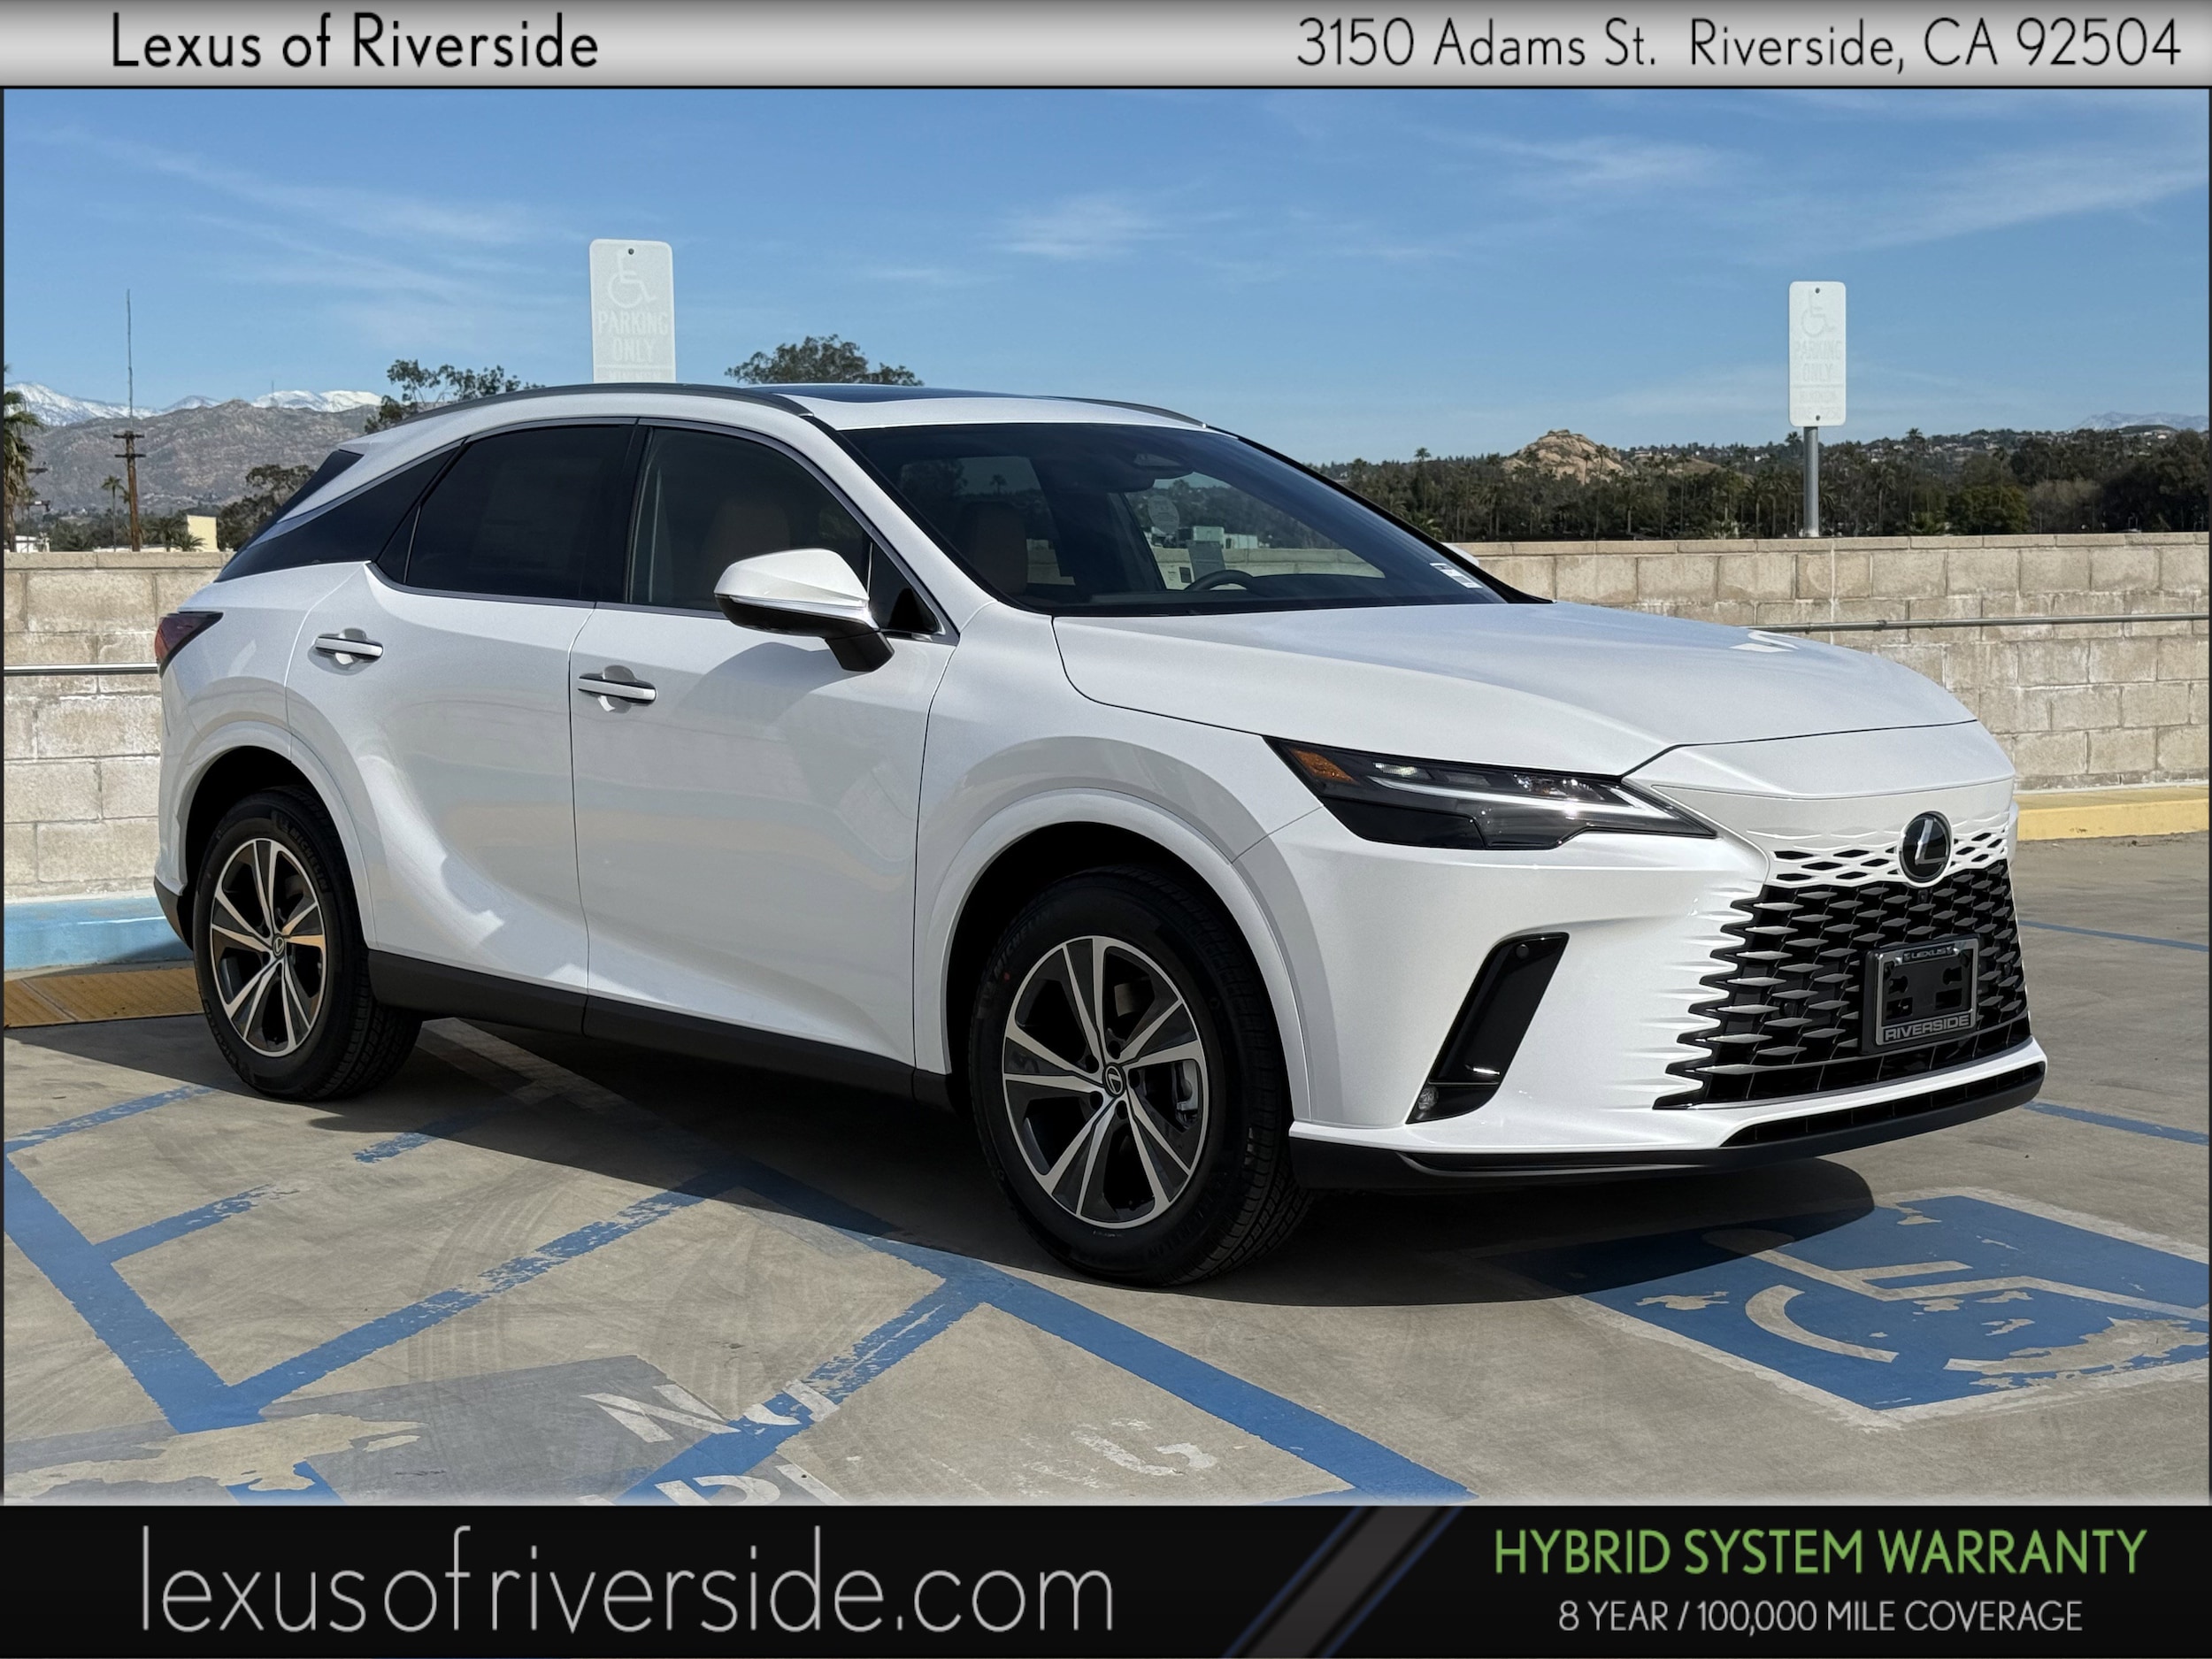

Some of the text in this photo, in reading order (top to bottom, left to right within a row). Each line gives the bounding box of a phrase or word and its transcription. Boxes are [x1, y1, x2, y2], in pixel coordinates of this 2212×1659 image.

[598, 310, 669, 335] PARKING
[611, 337, 657, 364] ONLY
[288, 827, 329, 890] MICHELIN
[1911, 947, 1947, 959] LEXUS
[1885, 1014, 1970, 1042] RIVERSIDE
